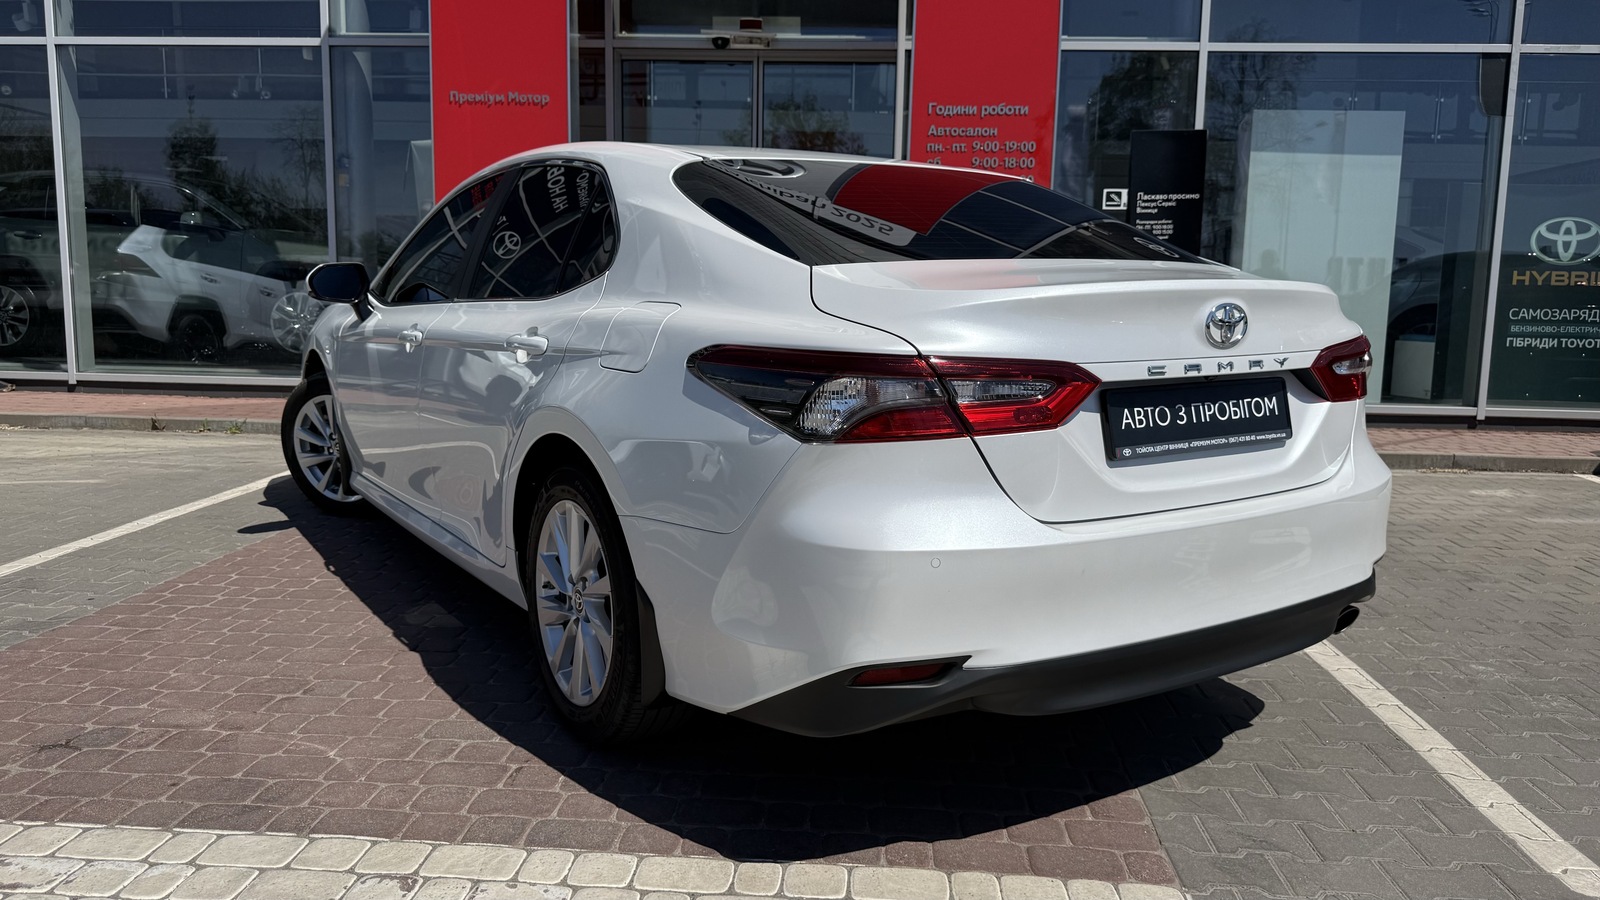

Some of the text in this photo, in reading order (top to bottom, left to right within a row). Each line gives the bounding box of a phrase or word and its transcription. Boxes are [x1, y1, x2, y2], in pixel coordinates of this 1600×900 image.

[449, 90, 551, 105] Преміум Мотор
[928, 102, 1029, 118] Години роботи
[927, 124, 998, 137] Автосалон
[972, 141, 1036, 153] 9:00-19:00
[971, 157, 1036, 169] 9:00-18:00
[1168, 193, 1201, 201] просимо
[1511, 270, 1600, 287] HYBRI
[1506, 337, 1558, 349] ГІБРИДИ
[1147, 357, 1290, 377] CAMRY
[1121, 405, 1171, 430] АВТО
[1191, 396, 1280, 424] ПРОБІГОМ
